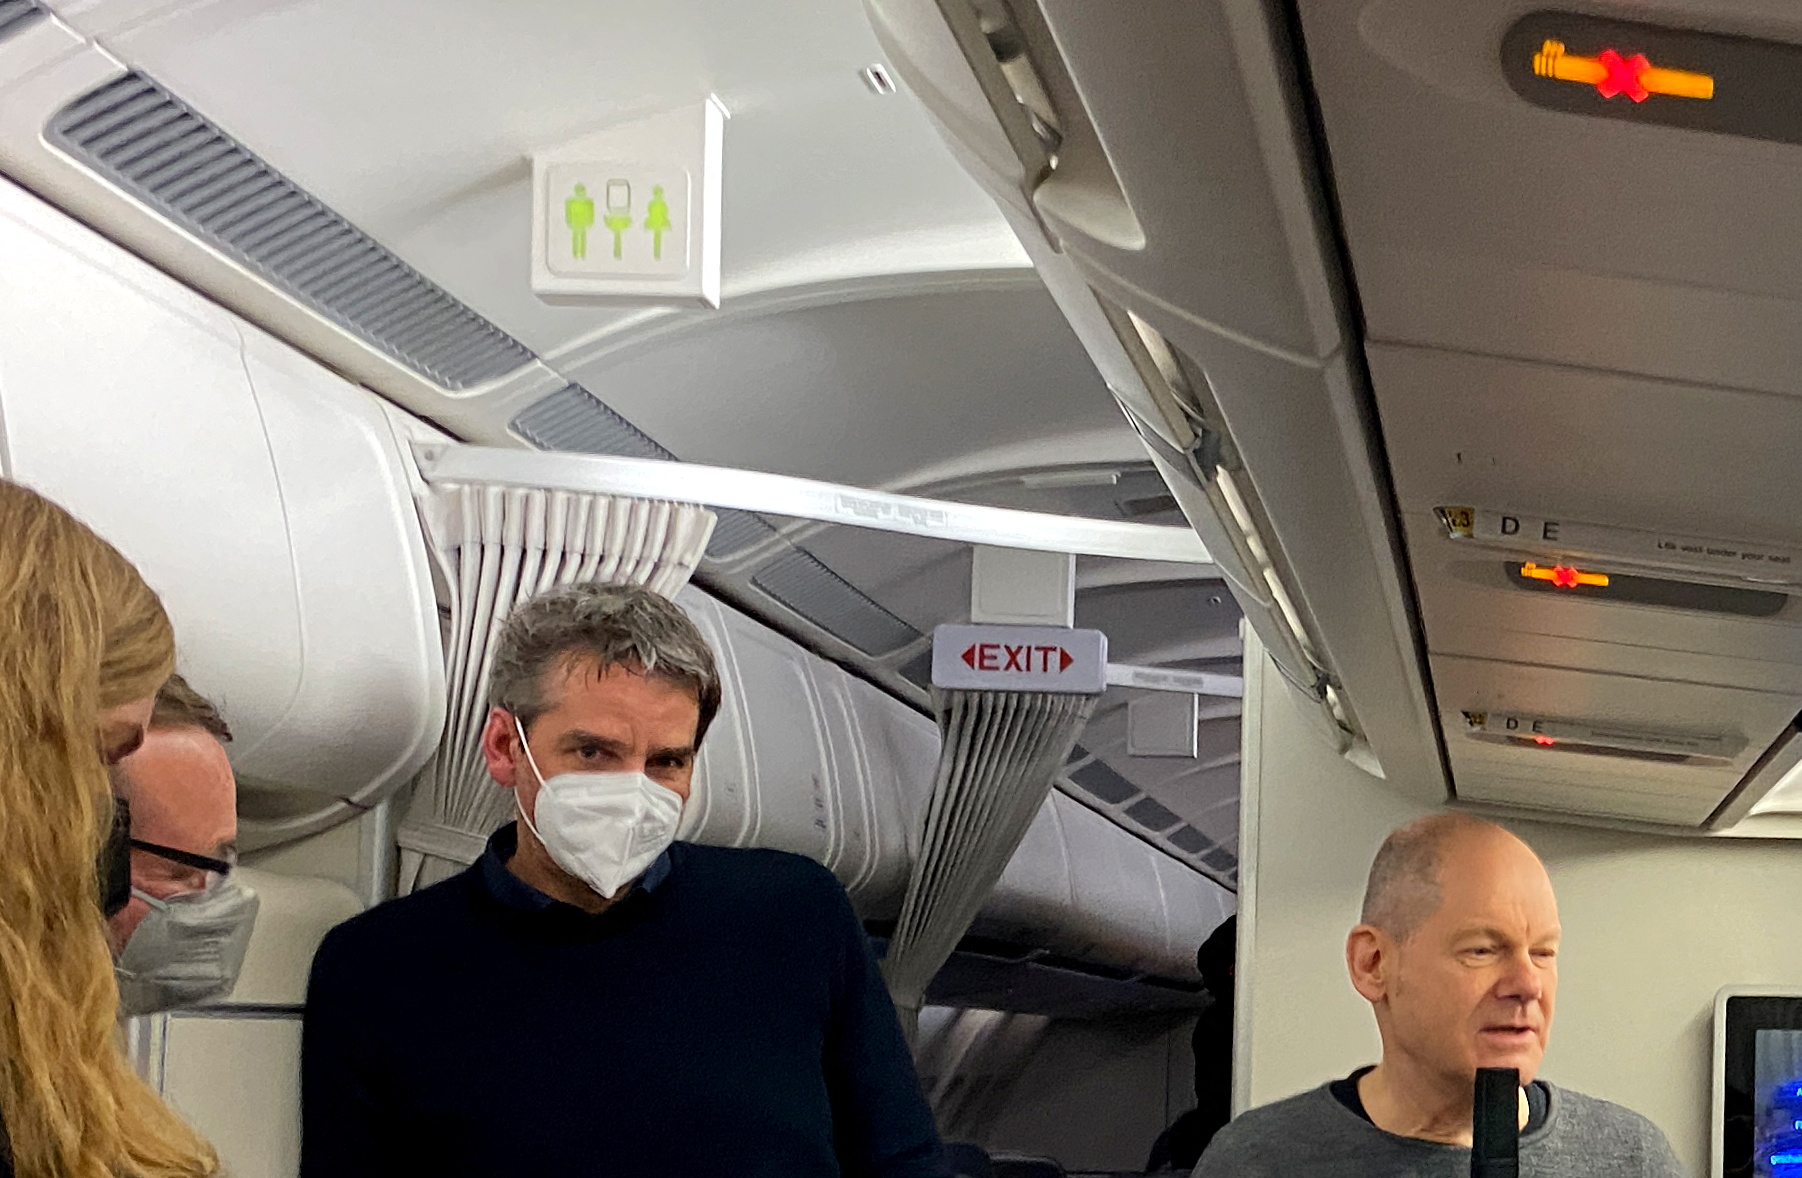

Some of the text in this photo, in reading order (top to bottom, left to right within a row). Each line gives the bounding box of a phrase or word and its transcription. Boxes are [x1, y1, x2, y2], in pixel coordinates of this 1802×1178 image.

[1501, 516, 1559, 541] D E
[979, 643, 1058, 673] EXIT
[1506, 717, 1519, 730] D
